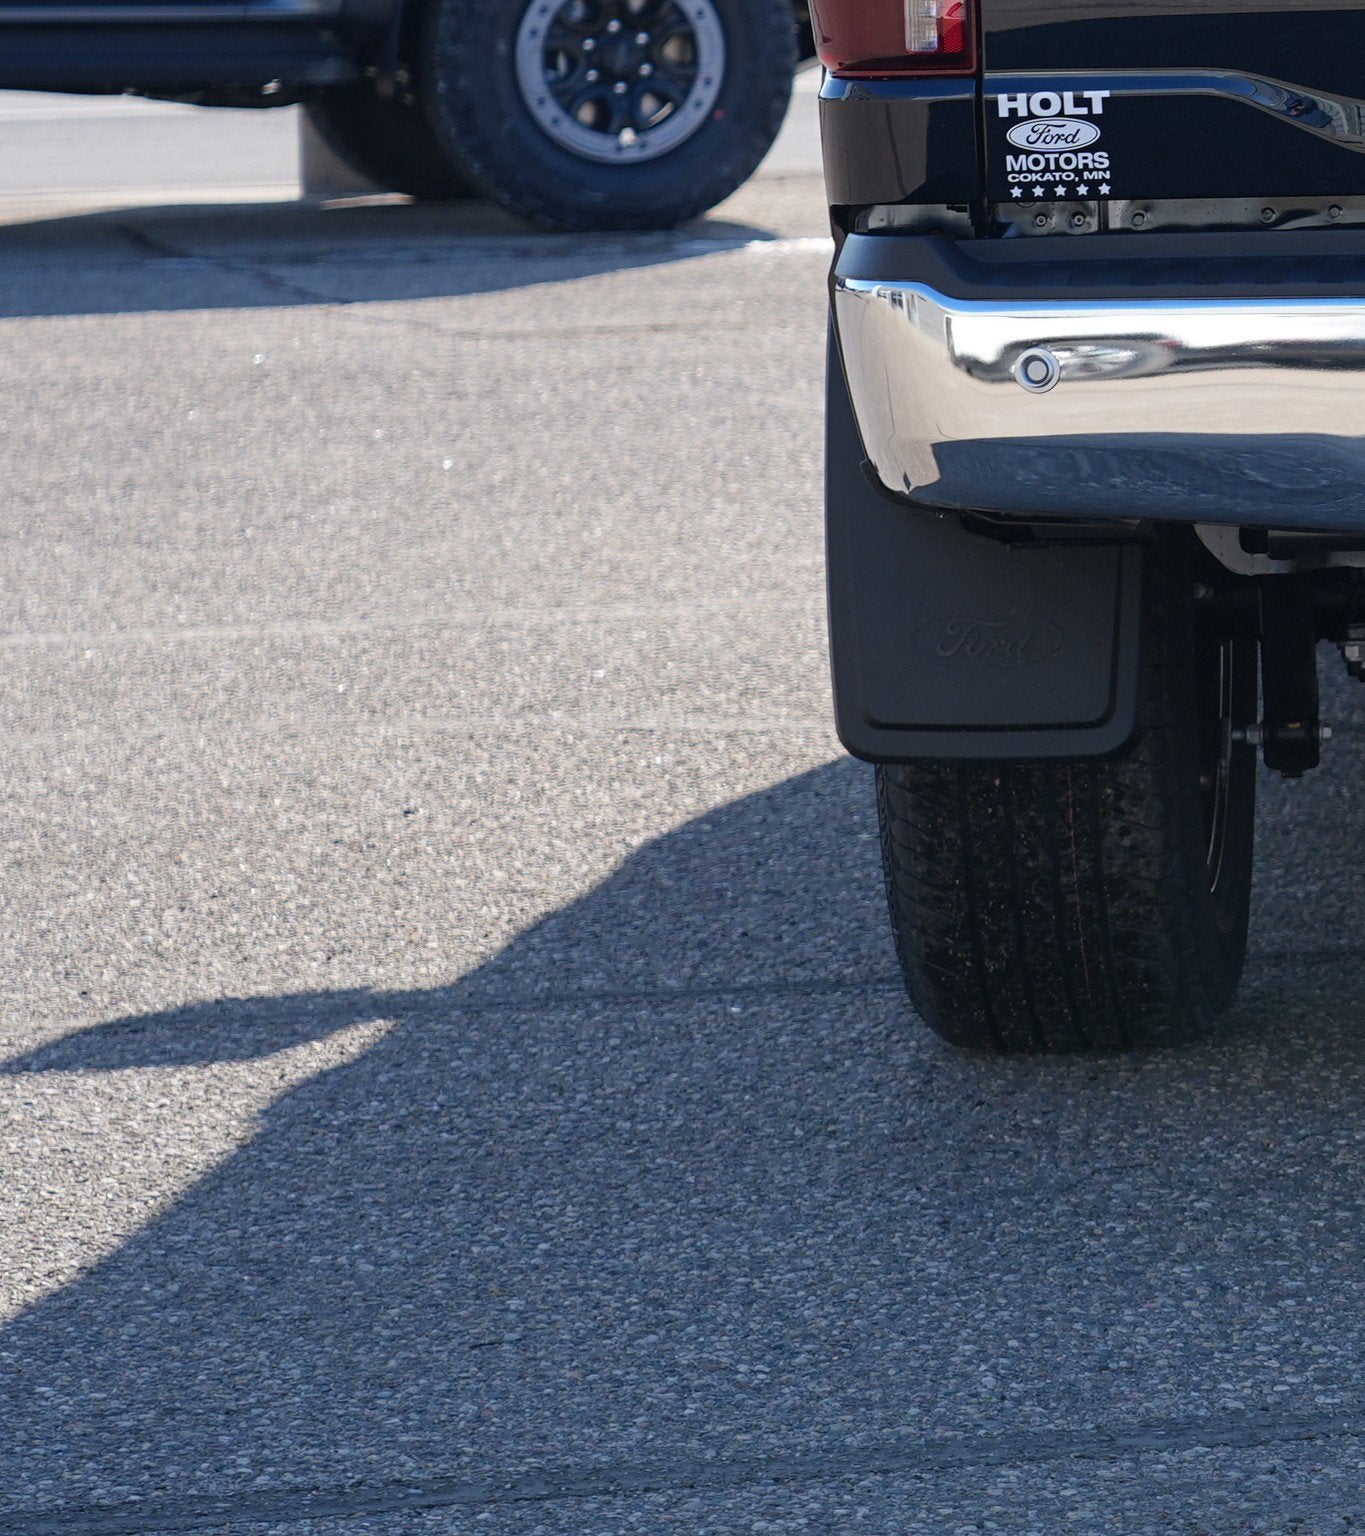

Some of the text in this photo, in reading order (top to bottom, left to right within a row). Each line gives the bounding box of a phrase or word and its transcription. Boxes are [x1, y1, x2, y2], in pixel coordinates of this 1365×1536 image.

[997, 90, 1111, 118] HOLT
[1026, 123, 1081, 145] Ford
[1005, 151, 1110, 172] MOTORS
[1007, 170, 1111, 183] COKATO, MN
